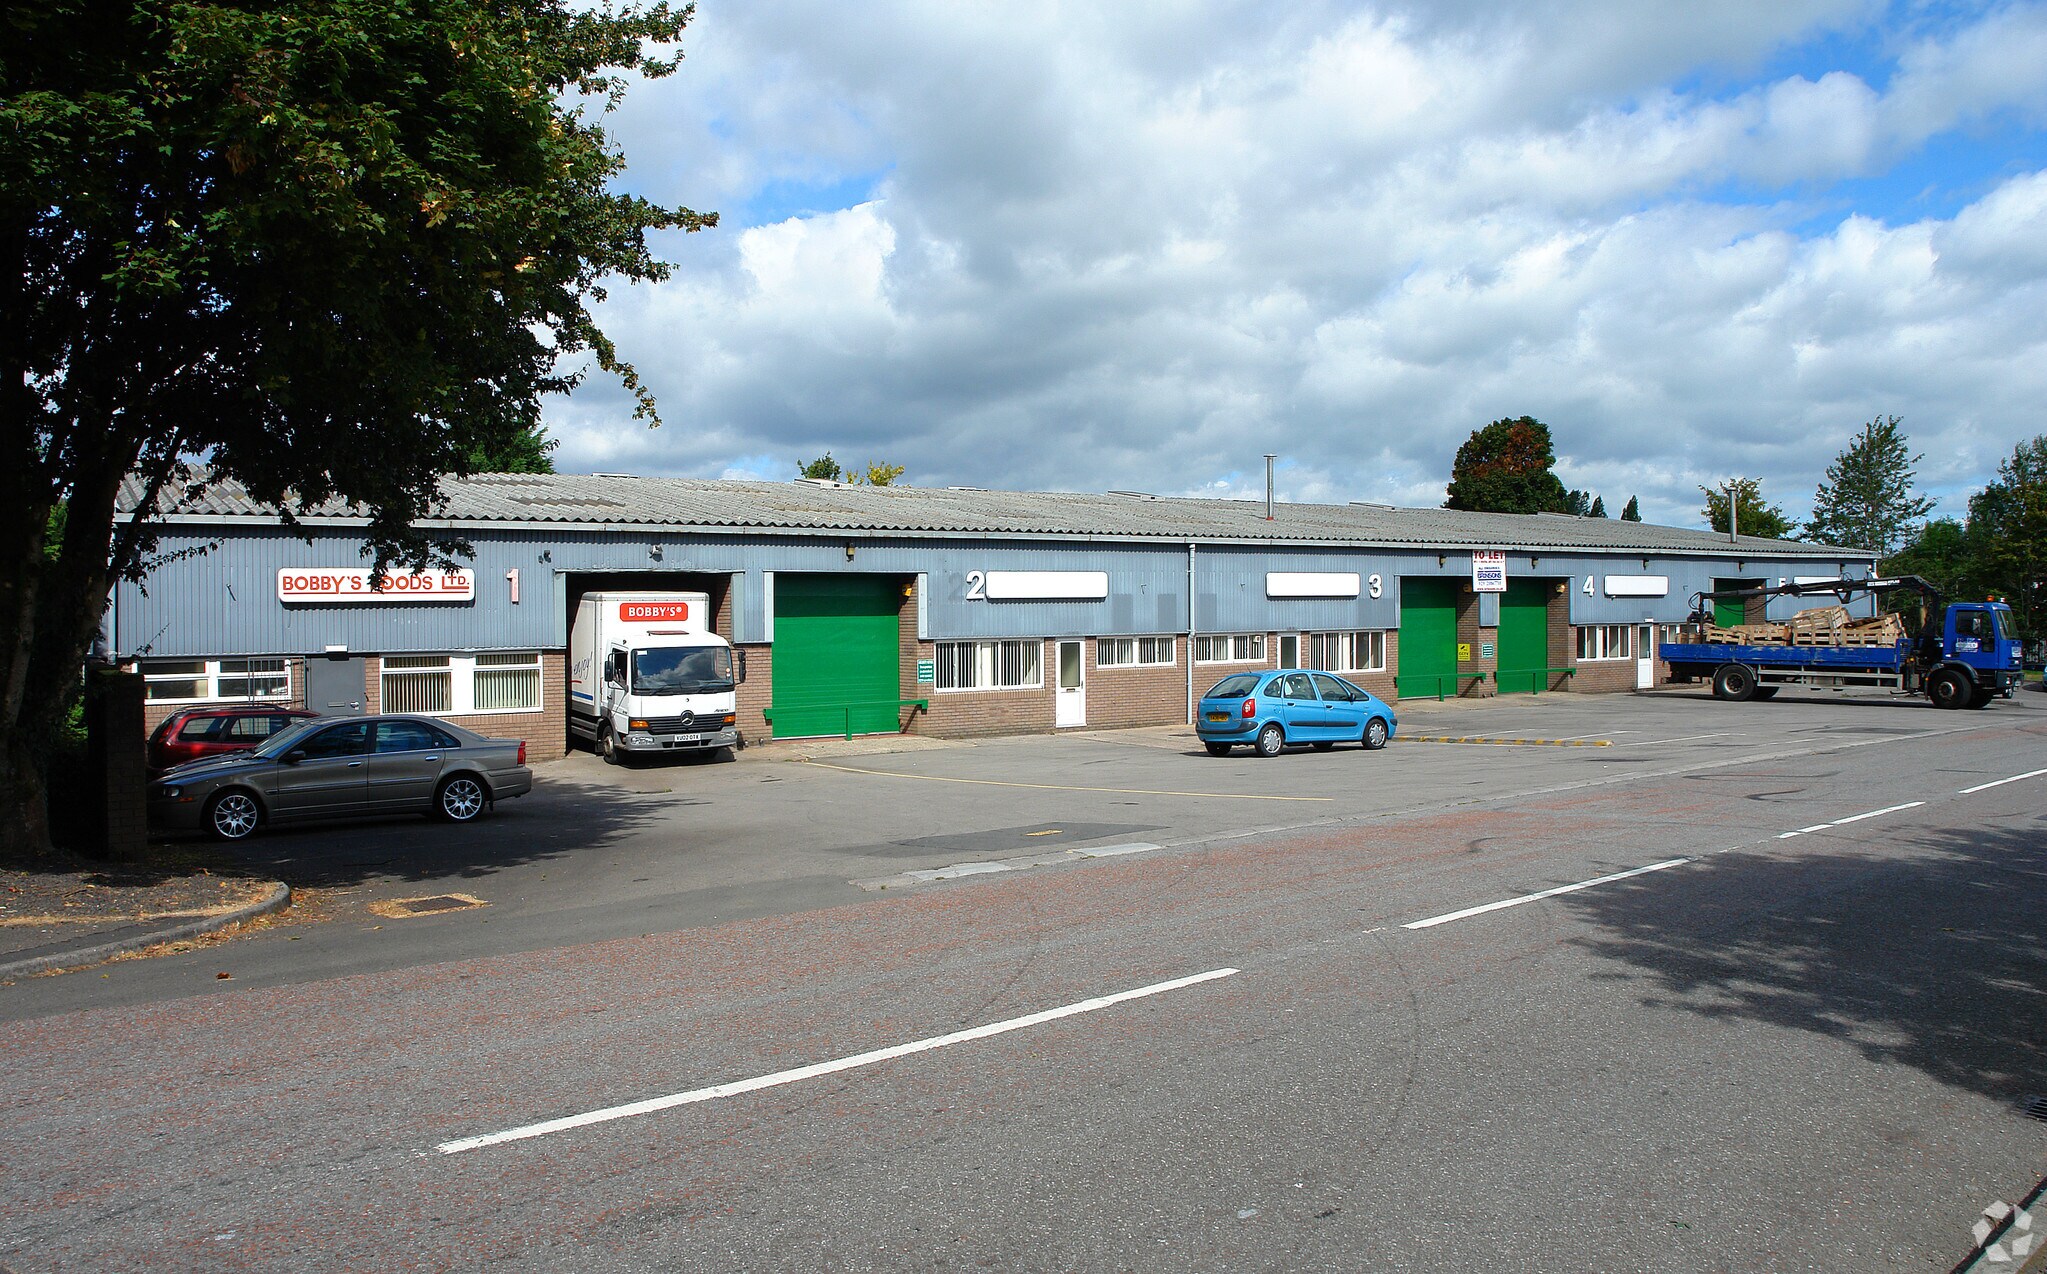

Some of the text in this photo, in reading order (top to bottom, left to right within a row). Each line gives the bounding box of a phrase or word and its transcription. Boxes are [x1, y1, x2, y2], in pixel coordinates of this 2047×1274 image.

[1473, 551, 1504, 559] TO LET
[282, 575, 362, 594] BOBBY'S
[374, 575, 433, 591] OODS
[505, 569, 519, 603] 1
[965, 570, 985, 600] 2
[1368, 574, 1382, 599] 3
[1582, 575, 1594, 597] 4
